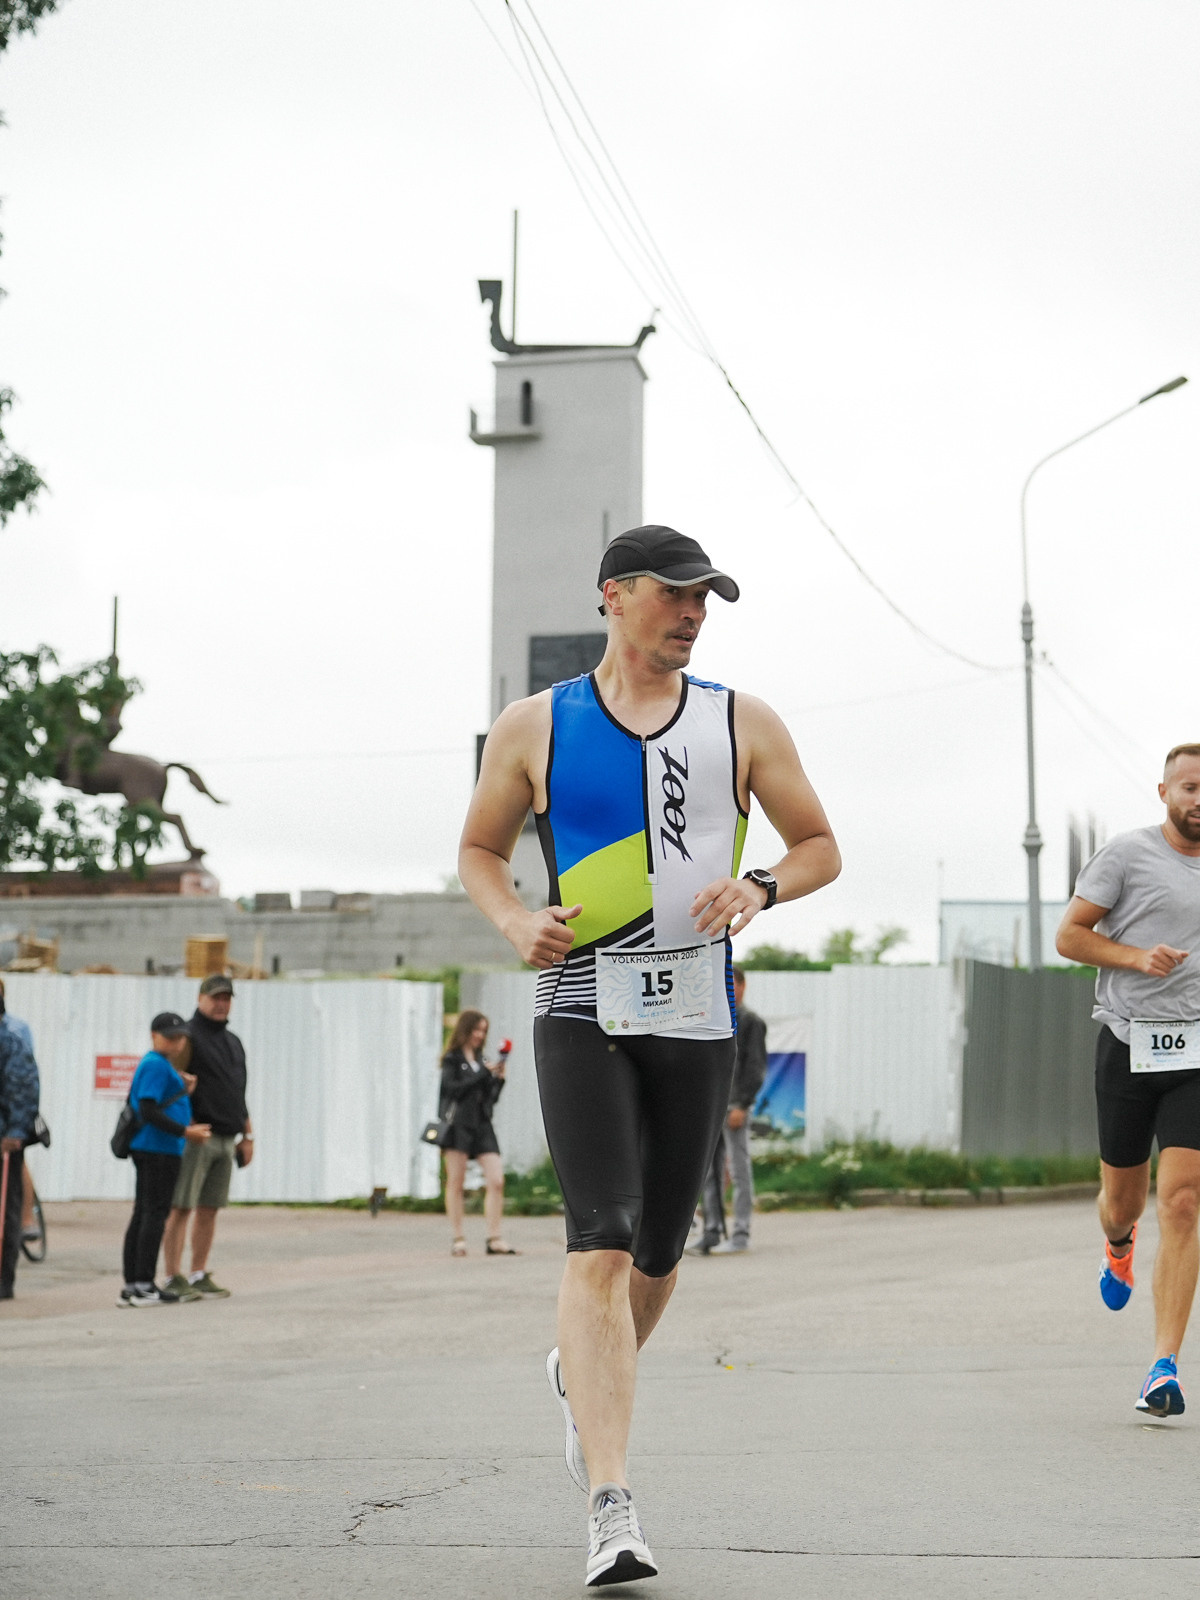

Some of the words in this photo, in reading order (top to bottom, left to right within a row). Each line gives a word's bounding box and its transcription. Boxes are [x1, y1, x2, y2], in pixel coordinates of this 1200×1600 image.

[611, 953, 679, 964] VOLKHOVMAN
[681, 950, 699, 960] 2023
[641, 970, 674, 997] 15
[642, 998, 673, 1008] МИХАИЛ
[1151, 1033, 1186, 1050] 106
